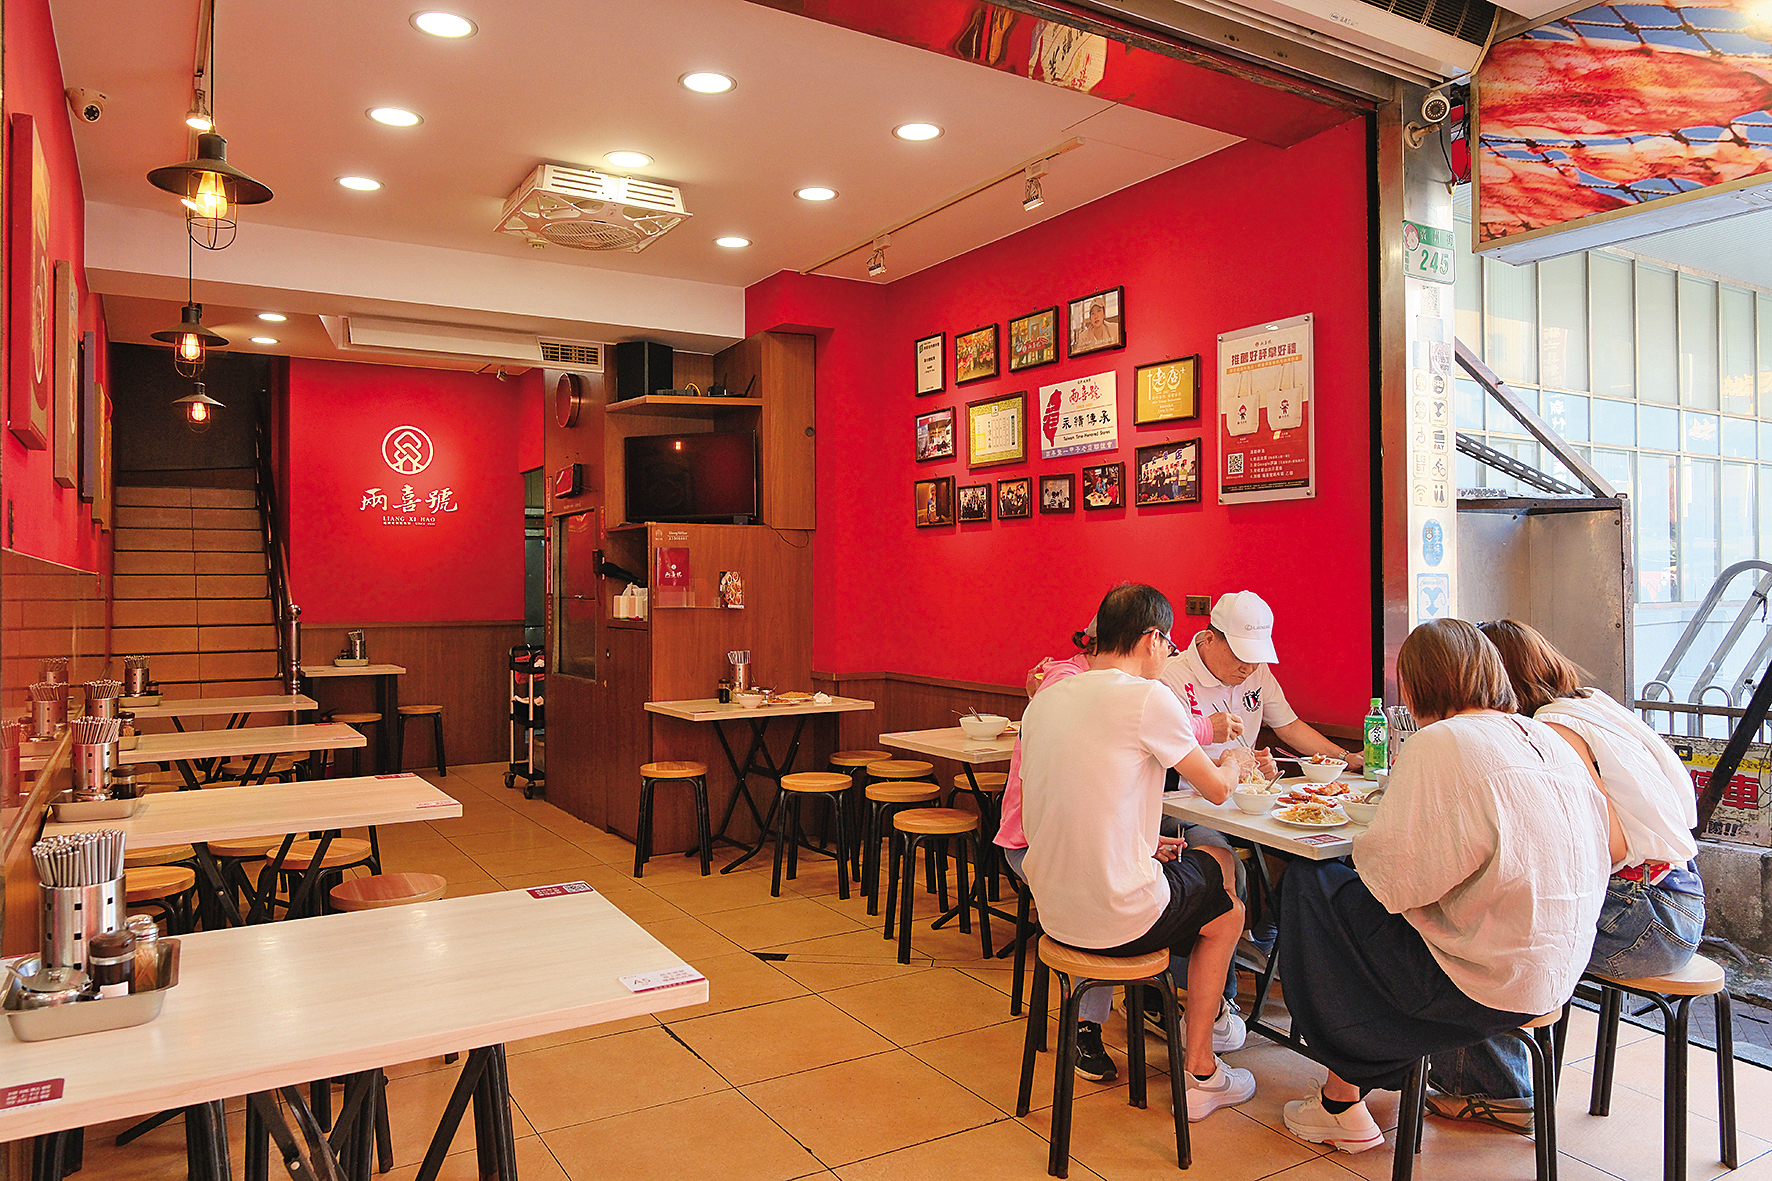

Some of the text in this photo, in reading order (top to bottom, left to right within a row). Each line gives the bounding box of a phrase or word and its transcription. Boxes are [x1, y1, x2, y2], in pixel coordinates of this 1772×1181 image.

[1420, 249, 1449, 275] 245
[359, 484, 459, 514] 兩喜號
